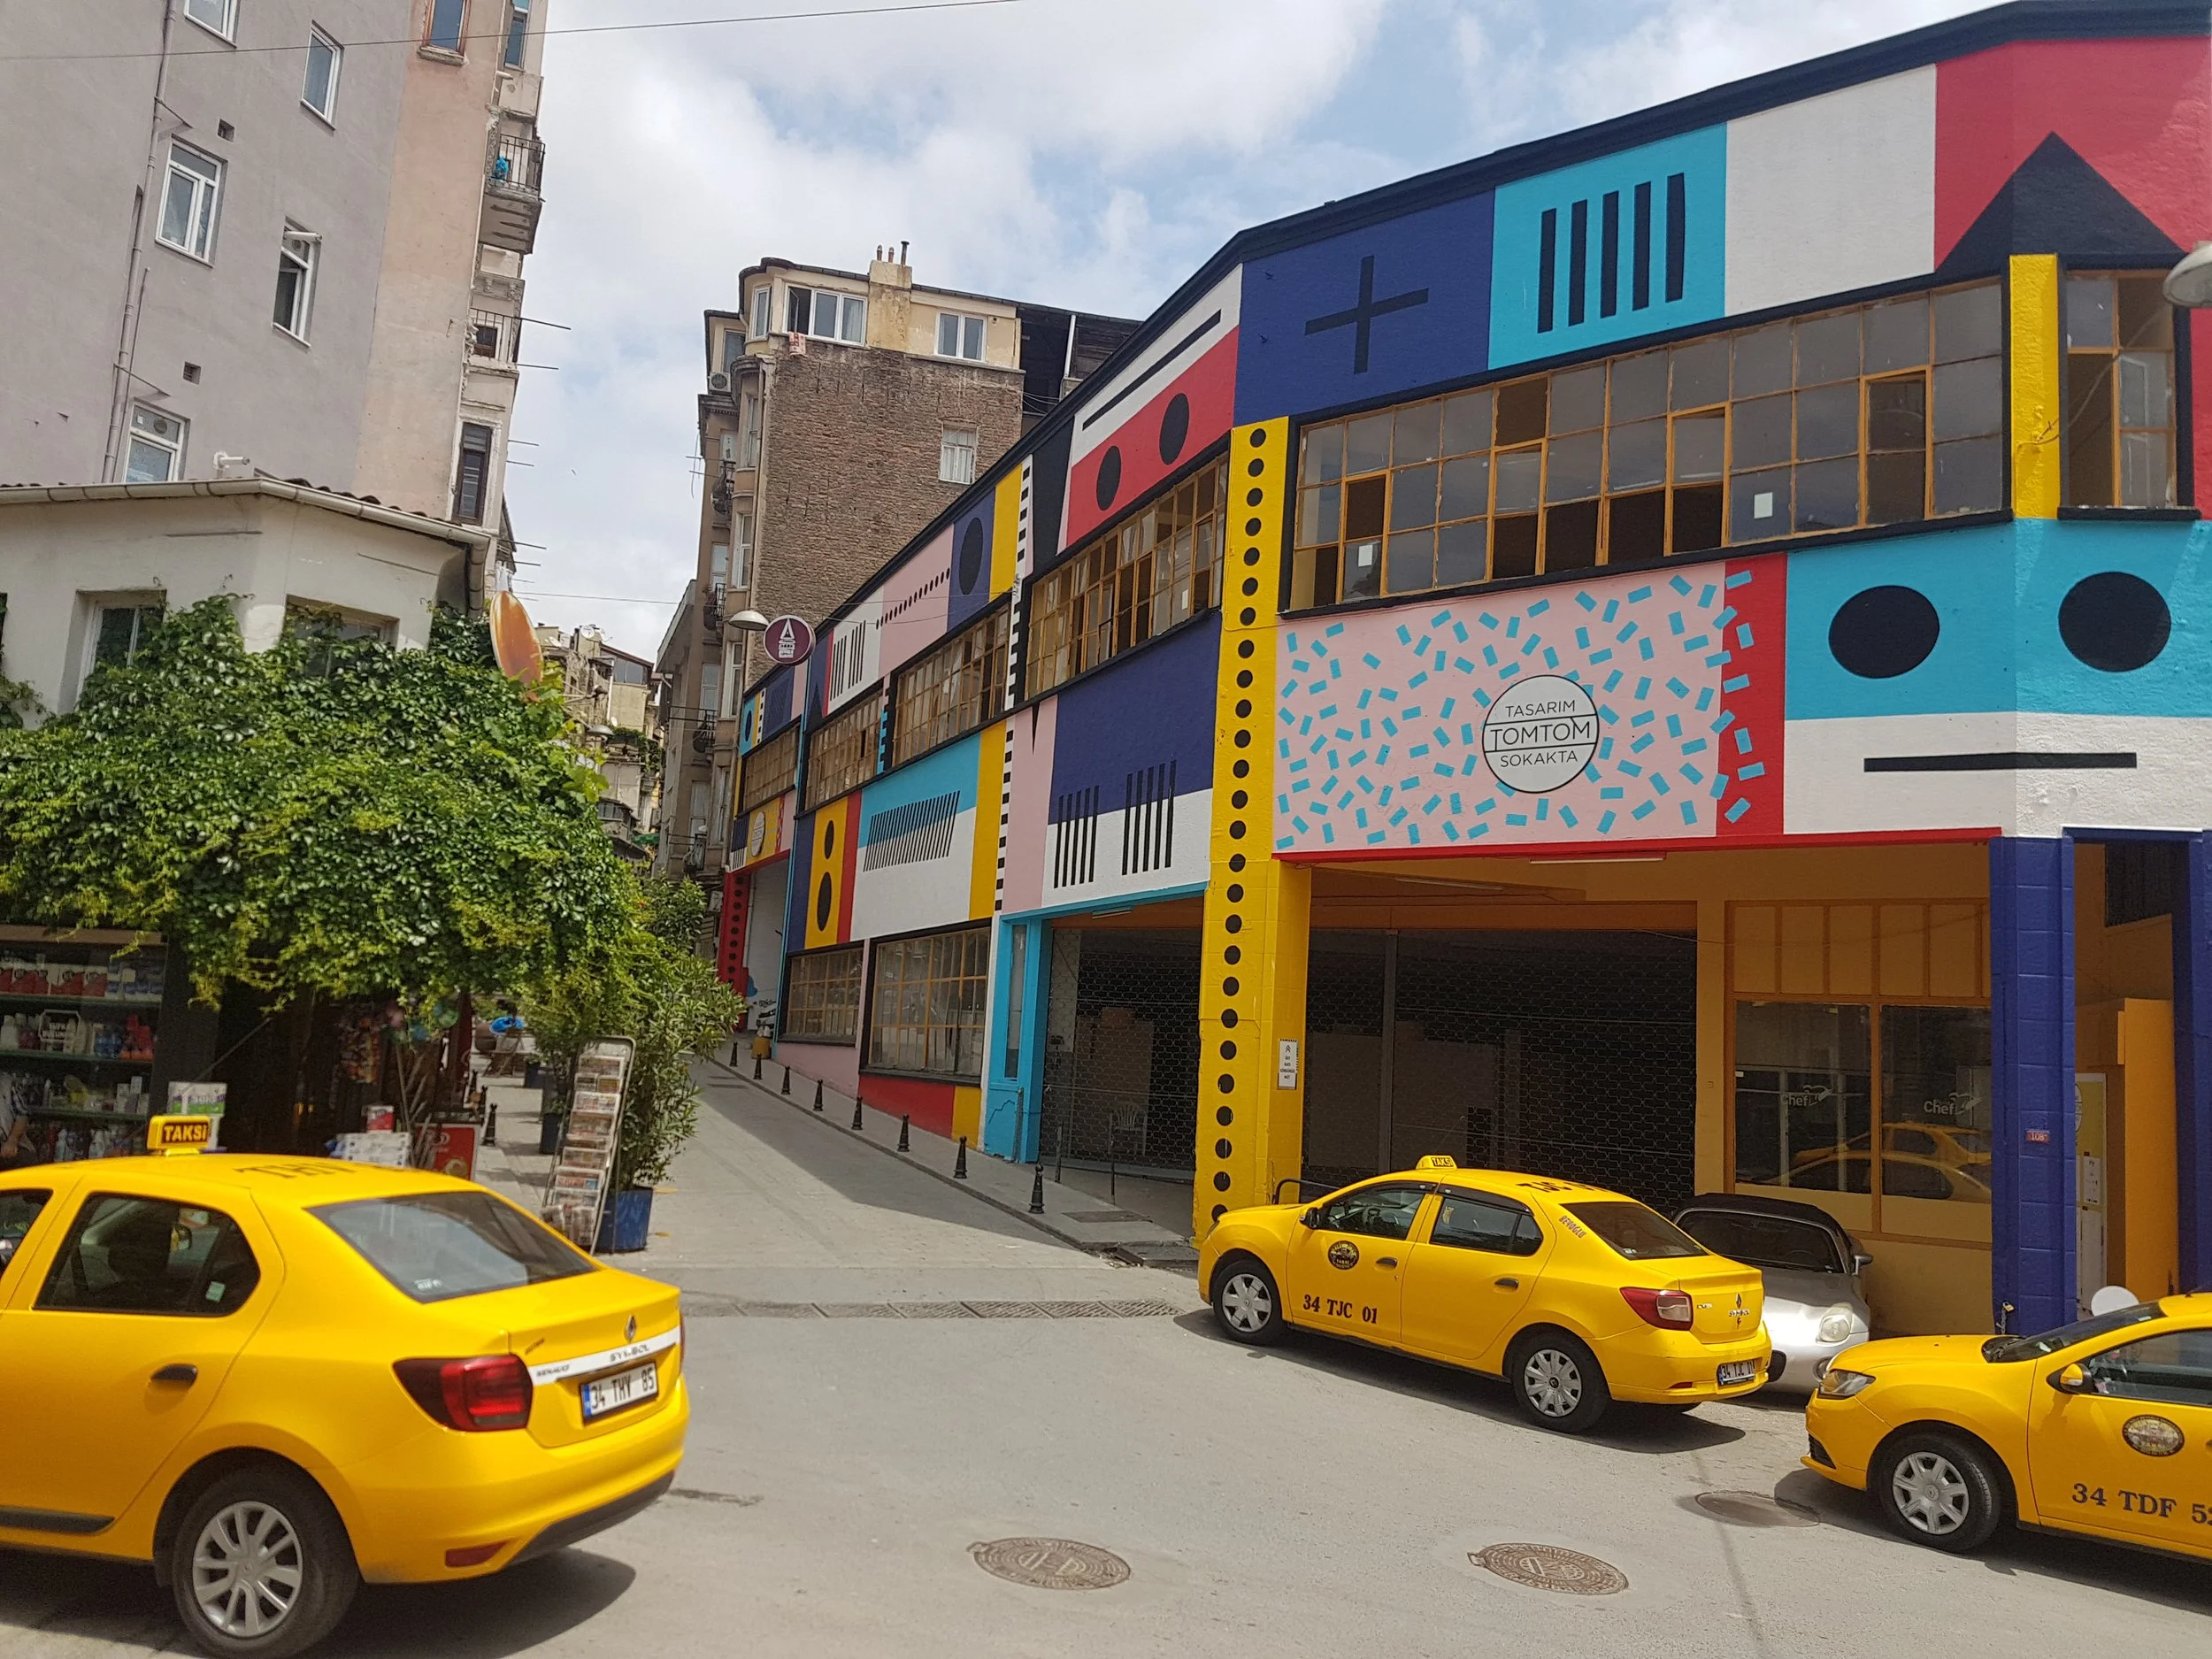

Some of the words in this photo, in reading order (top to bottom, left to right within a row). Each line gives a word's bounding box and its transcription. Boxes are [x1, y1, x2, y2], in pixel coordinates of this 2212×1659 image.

[1505, 700, 1576, 718] TASARIM
[1490, 718, 1590, 751] TOMTOM
[1501, 750, 1578, 767] SOKAKTA
[1924, 1100, 1955, 1115] Chef
[1303, 1294, 1320, 1312] 34
[1327, 1299, 1352, 1318] TJC
[1363, 1306, 1378, 1324] 01
[1722, 1365, 1731, 1379] 34
[1733, 1363, 1745, 1377] TJC
[591, 1384, 606, 1409] 34
[611, 1374, 631, 1402] THY
[641, 1367, 655, 1392] 85
[2072, 1483, 2108, 1506] 34
[2118, 1490, 2177, 1517] TDF
